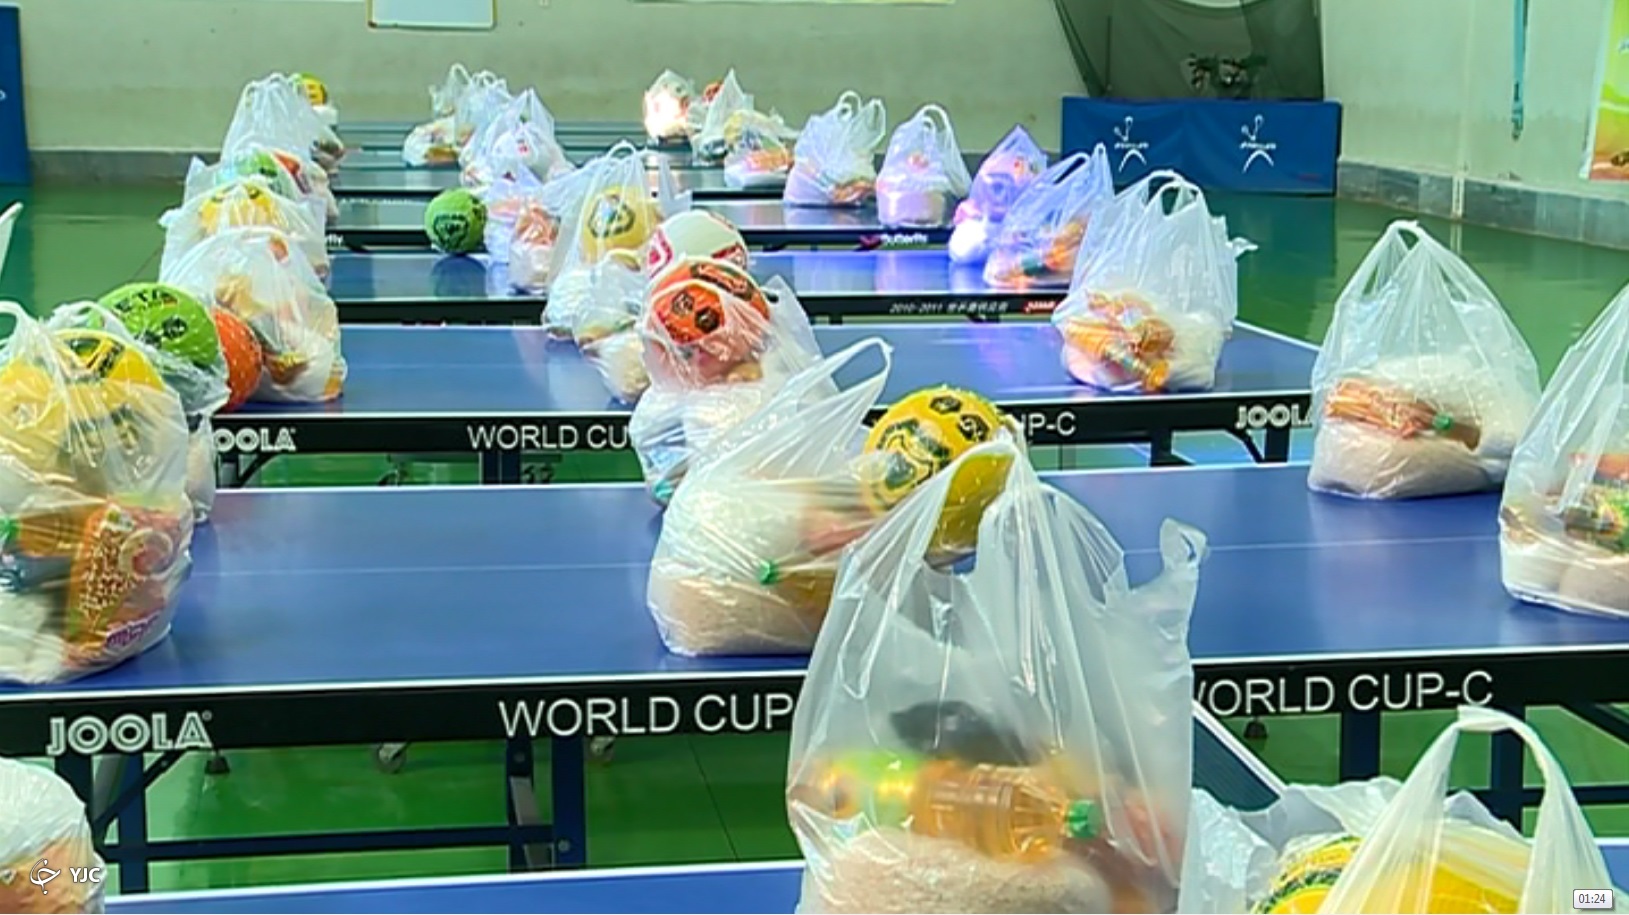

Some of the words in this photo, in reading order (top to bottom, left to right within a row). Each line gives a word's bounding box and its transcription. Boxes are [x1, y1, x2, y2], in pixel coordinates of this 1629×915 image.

[1021, 410, 1077, 437] P-C
[1234, 402, 1311, 430] JOOL
[213, 427, 297, 452] OOLA
[467, 424, 580, 450] WORLD
[586, 424, 629, 449] CU
[1198, 675, 1335, 716] ORLD
[1348, 670, 1493, 711] CUP-C
[499, 695, 681, 738] WORLD
[693, 692, 795, 732] CUP
[46, 710, 213, 755] JOOLA
